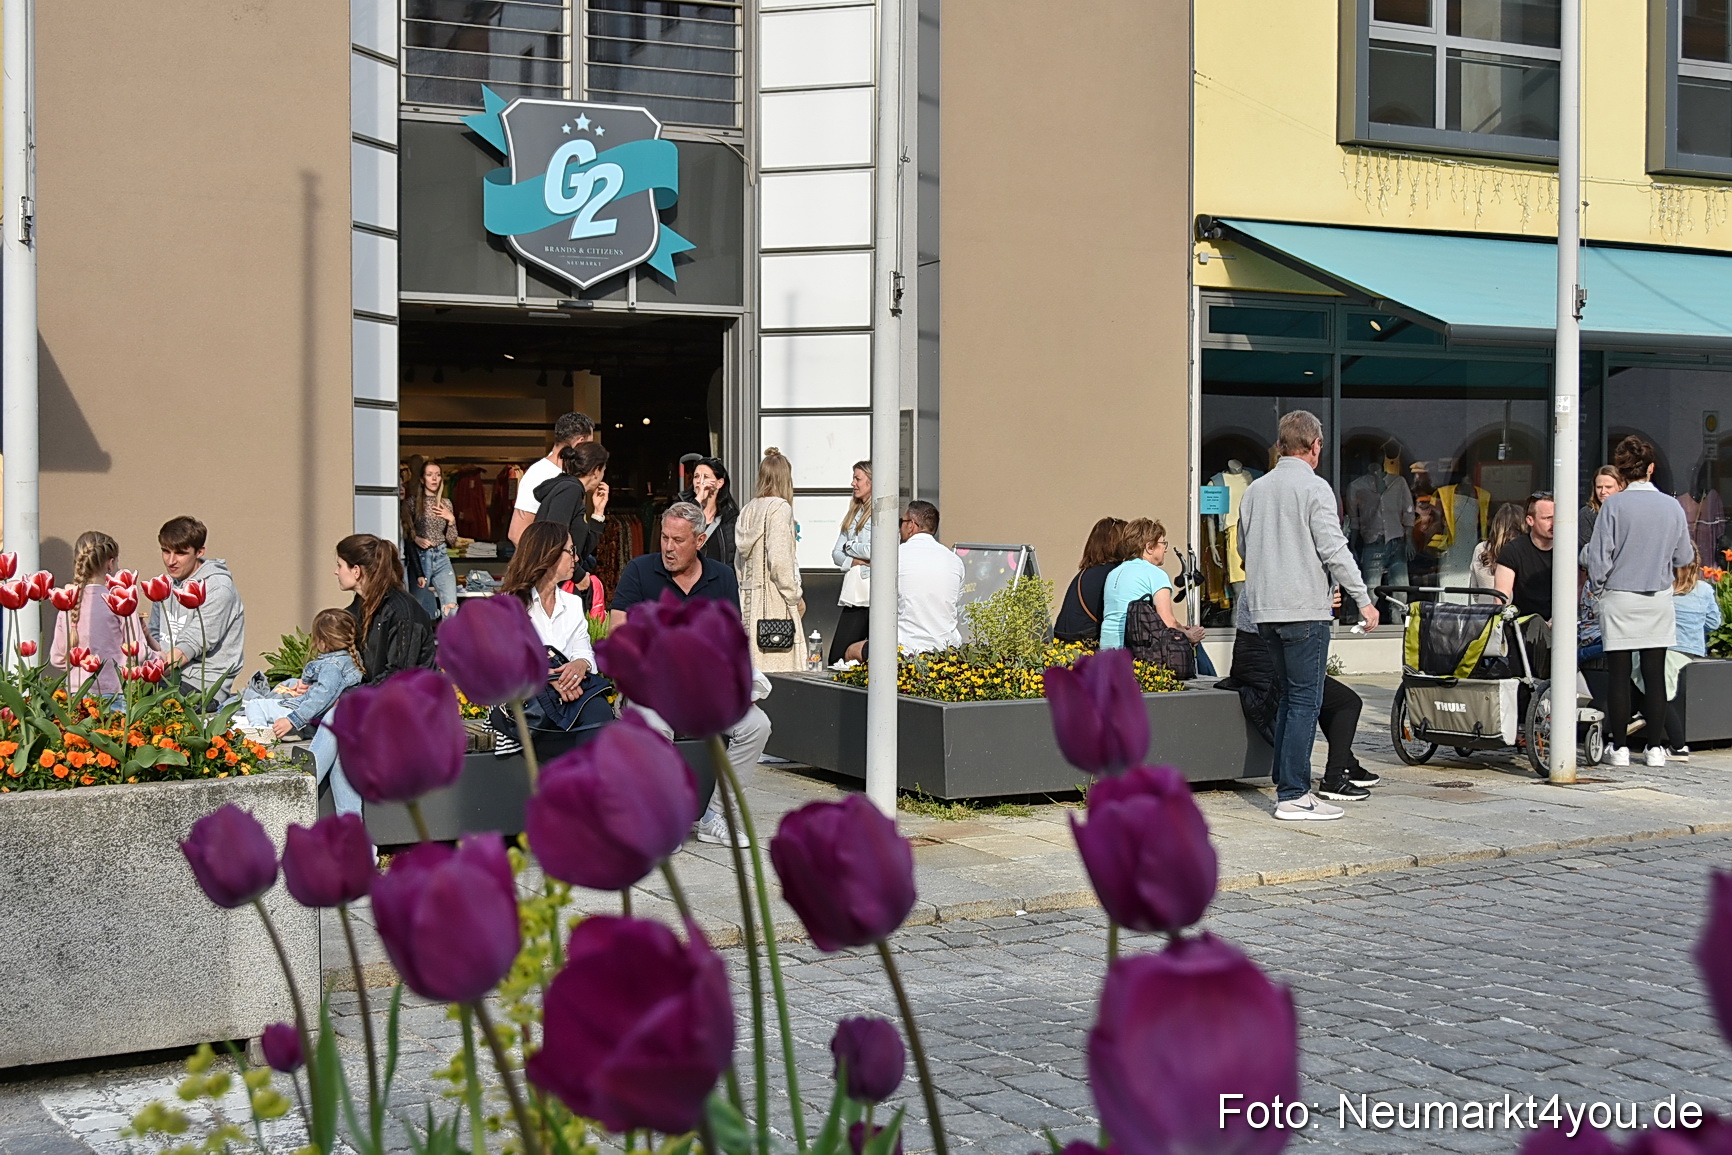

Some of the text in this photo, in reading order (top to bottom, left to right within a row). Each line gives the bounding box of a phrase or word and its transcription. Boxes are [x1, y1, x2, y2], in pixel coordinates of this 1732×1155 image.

[544, 138, 624, 241] G2
[544, 245, 577, 253] BRANDS
[586, 247, 624, 256] CITIZENS
[1434, 701, 1467, 712] THULE
